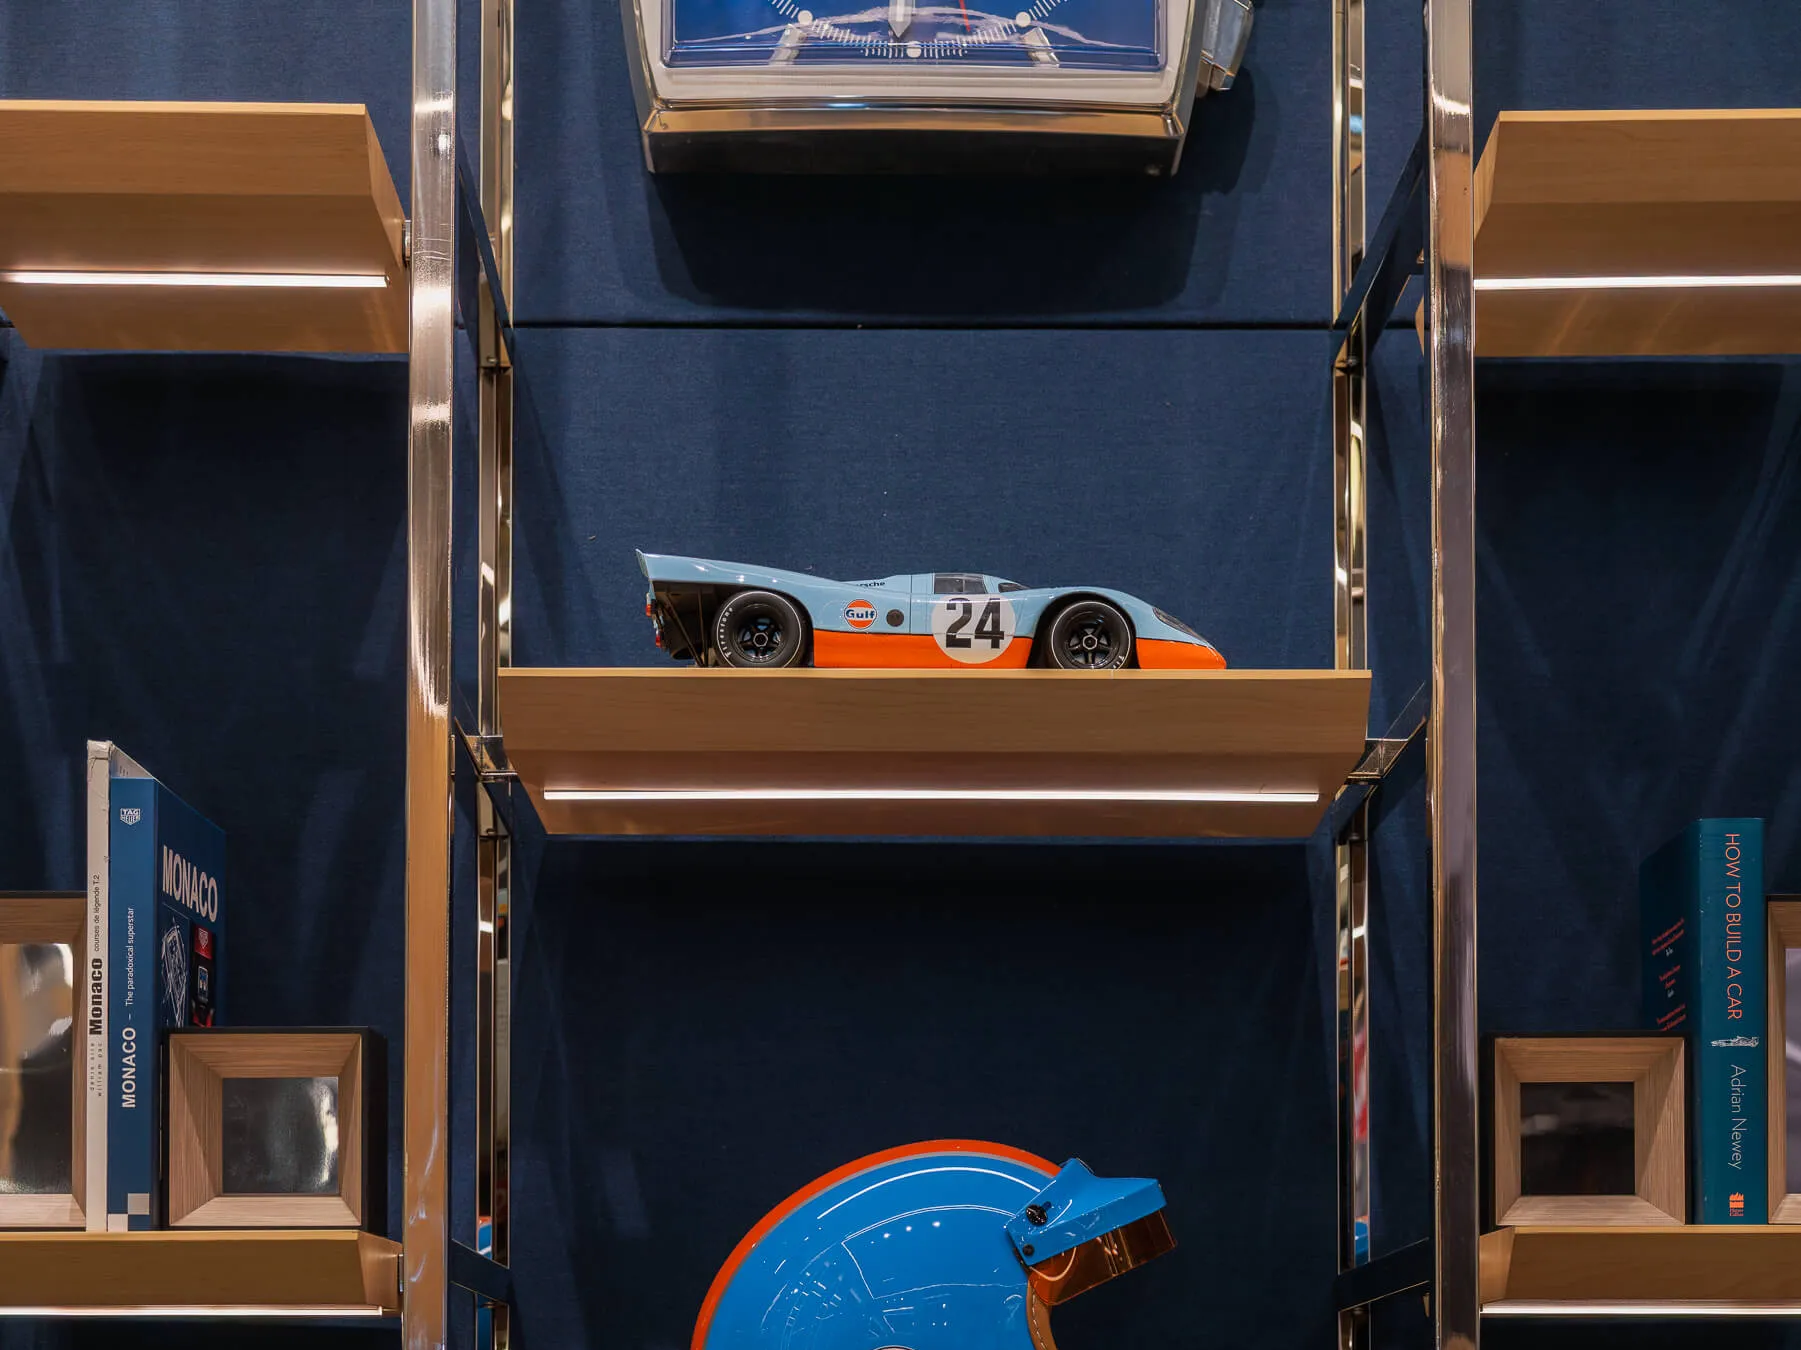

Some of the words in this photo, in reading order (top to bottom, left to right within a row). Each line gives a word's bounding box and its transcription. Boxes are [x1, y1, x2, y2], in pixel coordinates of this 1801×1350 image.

[845, 608, 875, 620] Gulf
[945, 597, 1005, 649] 24
[1724, 833, 1741, 878] HOW
[162, 845, 218, 923] MONACO
[1725, 882, 1741, 908] TO
[93, 914, 101, 924] de
[127, 907, 136, 944] superstar
[1726, 913, 1742, 962] BUILD
[125, 945, 136, 990] paradoxical
[1727, 966, 1743, 979] A
[89, 958, 103, 1036] Monaco
[125, 991, 134, 1007] The
[1726, 983, 1743, 1020] CAR
[121, 1027, 136, 1108] MONACO
[1730, 1064, 1747, 1113] Adrian
[1728, 1118, 1747, 1170] Newey
